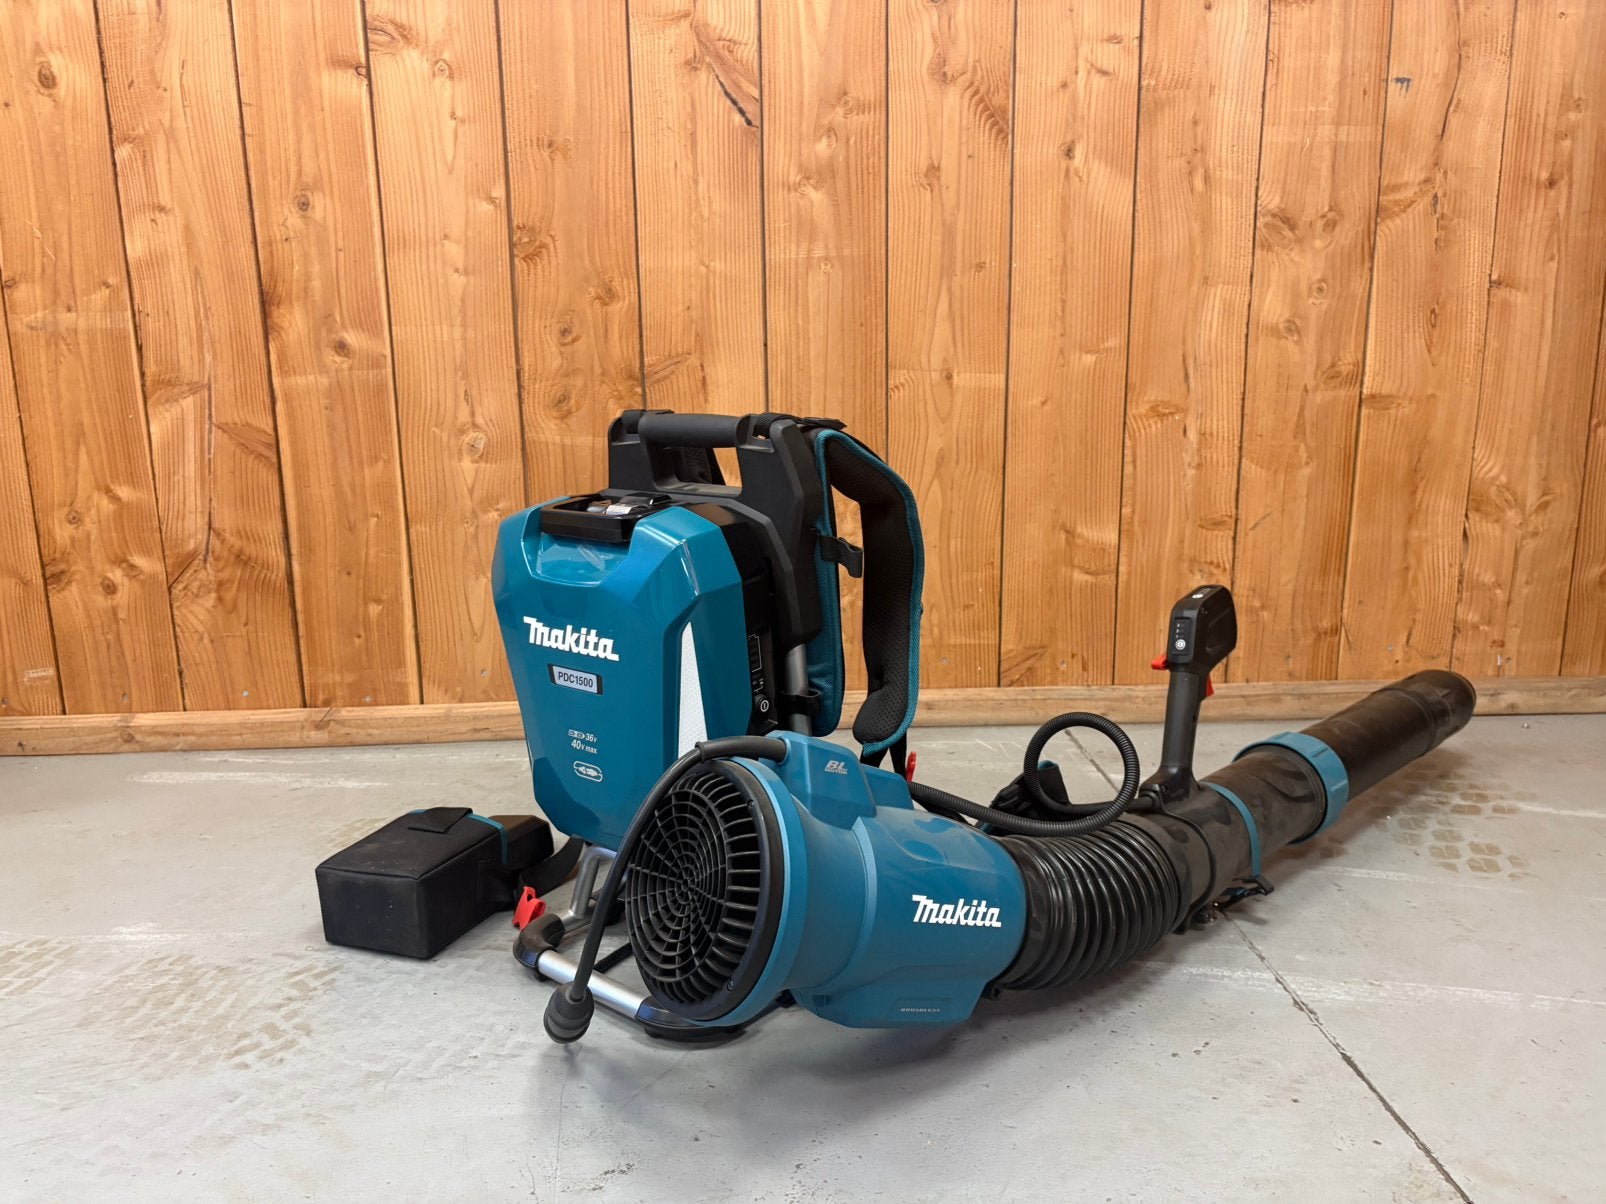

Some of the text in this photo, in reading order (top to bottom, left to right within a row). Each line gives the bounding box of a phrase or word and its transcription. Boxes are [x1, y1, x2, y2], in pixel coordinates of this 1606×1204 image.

[523, 615, 620, 662] Makita
[558, 671, 594, 688] PDC1500
[585, 745, 598, 754] max
[912, 894, 1002, 928] Makita
